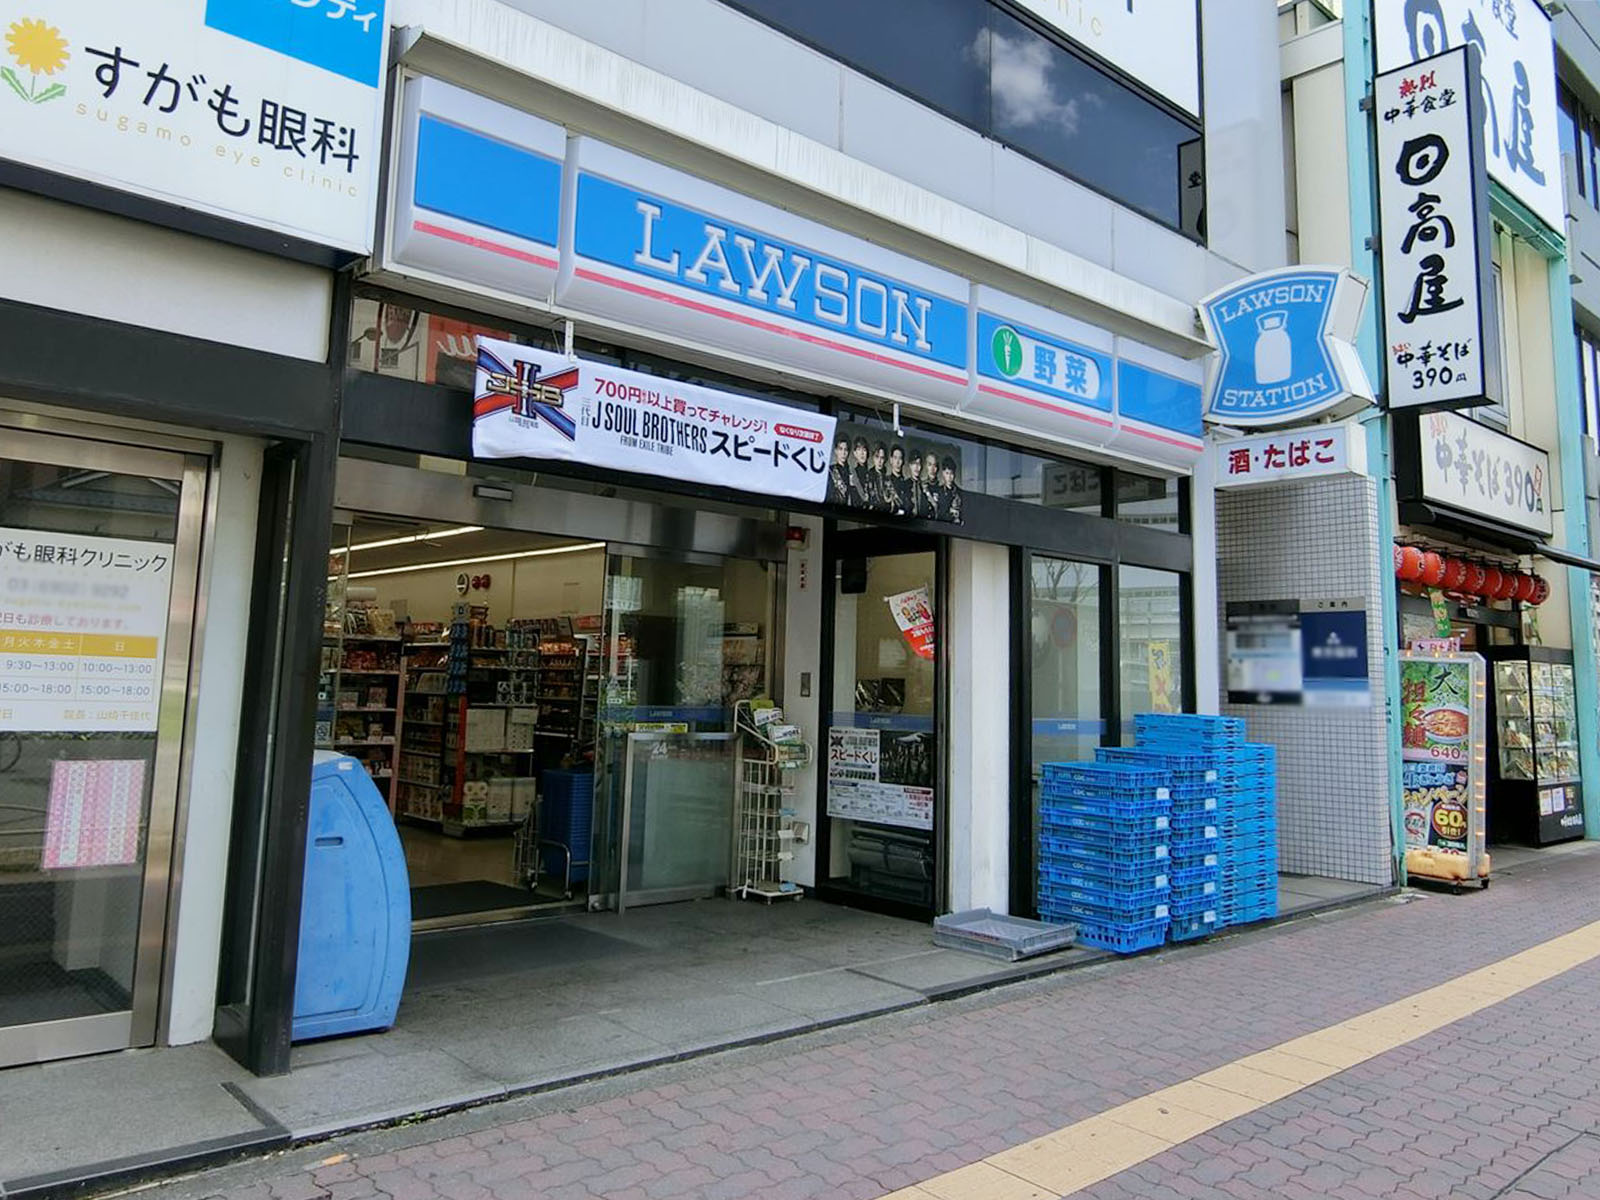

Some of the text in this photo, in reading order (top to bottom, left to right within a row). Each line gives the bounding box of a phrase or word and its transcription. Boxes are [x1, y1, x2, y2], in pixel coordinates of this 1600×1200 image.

[1398, 70, 1437, 98] 熱烈
[85, 46, 359, 173] すがも眼科
[1384, 88, 1457, 123] 中華食堂
[76, 103, 358, 197] sugamo eye clinic
[1395, 133, 1464, 324] 日高屋
[634, 201, 933, 352] LAWSON
[1220, 284, 1326, 323] LAWSON
[1034, 345, 1087, 395] 野菜
[1397, 338, 1472, 368] 中華そば
[1222, 372, 1328, 408] STATION
[1412, 366, 1467, 389] 390円
[592, 401, 708, 454] J SOUL BROTHERS
[619, 435, 674, 457] FROM EXILE TRIBE
[709, 430, 826, 474] スピードくじ
[1228, 438, 1335, 475] 酒・たばこ
[831, 748, 877, 764] スピードくじ
